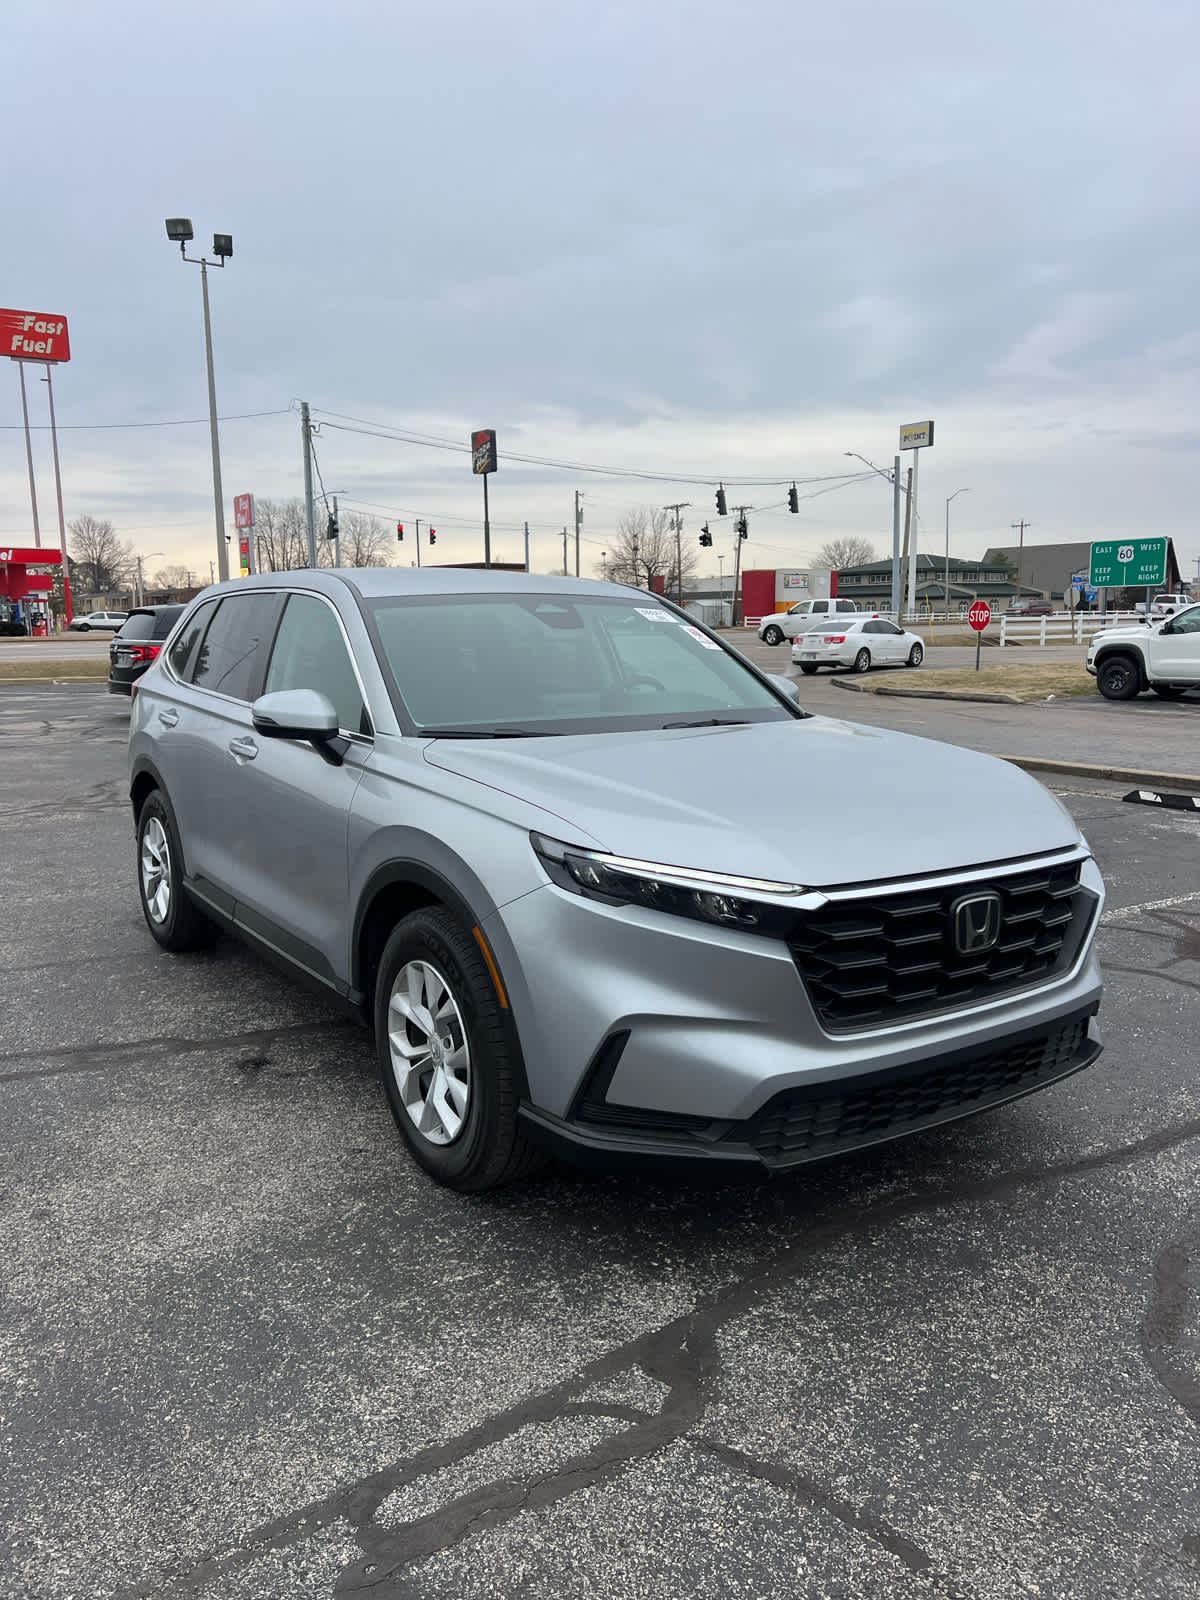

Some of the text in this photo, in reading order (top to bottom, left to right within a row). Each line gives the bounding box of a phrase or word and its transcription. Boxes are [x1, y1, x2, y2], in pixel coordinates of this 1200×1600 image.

[23, 315, 64, 336] Fast
[11, 334, 54, 355] Fuel
[1095, 546, 1113, 554] EAST
[1140, 543, 1161, 551] WEST
[1119, 548, 1133, 560] 60
[1140, 564, 1159, 572] KEEP
[1095, 575, 1111, 583] LEFT
[1138, 573, 1160, 581] RIGHT
[969, 610, 990, 622] STOP
